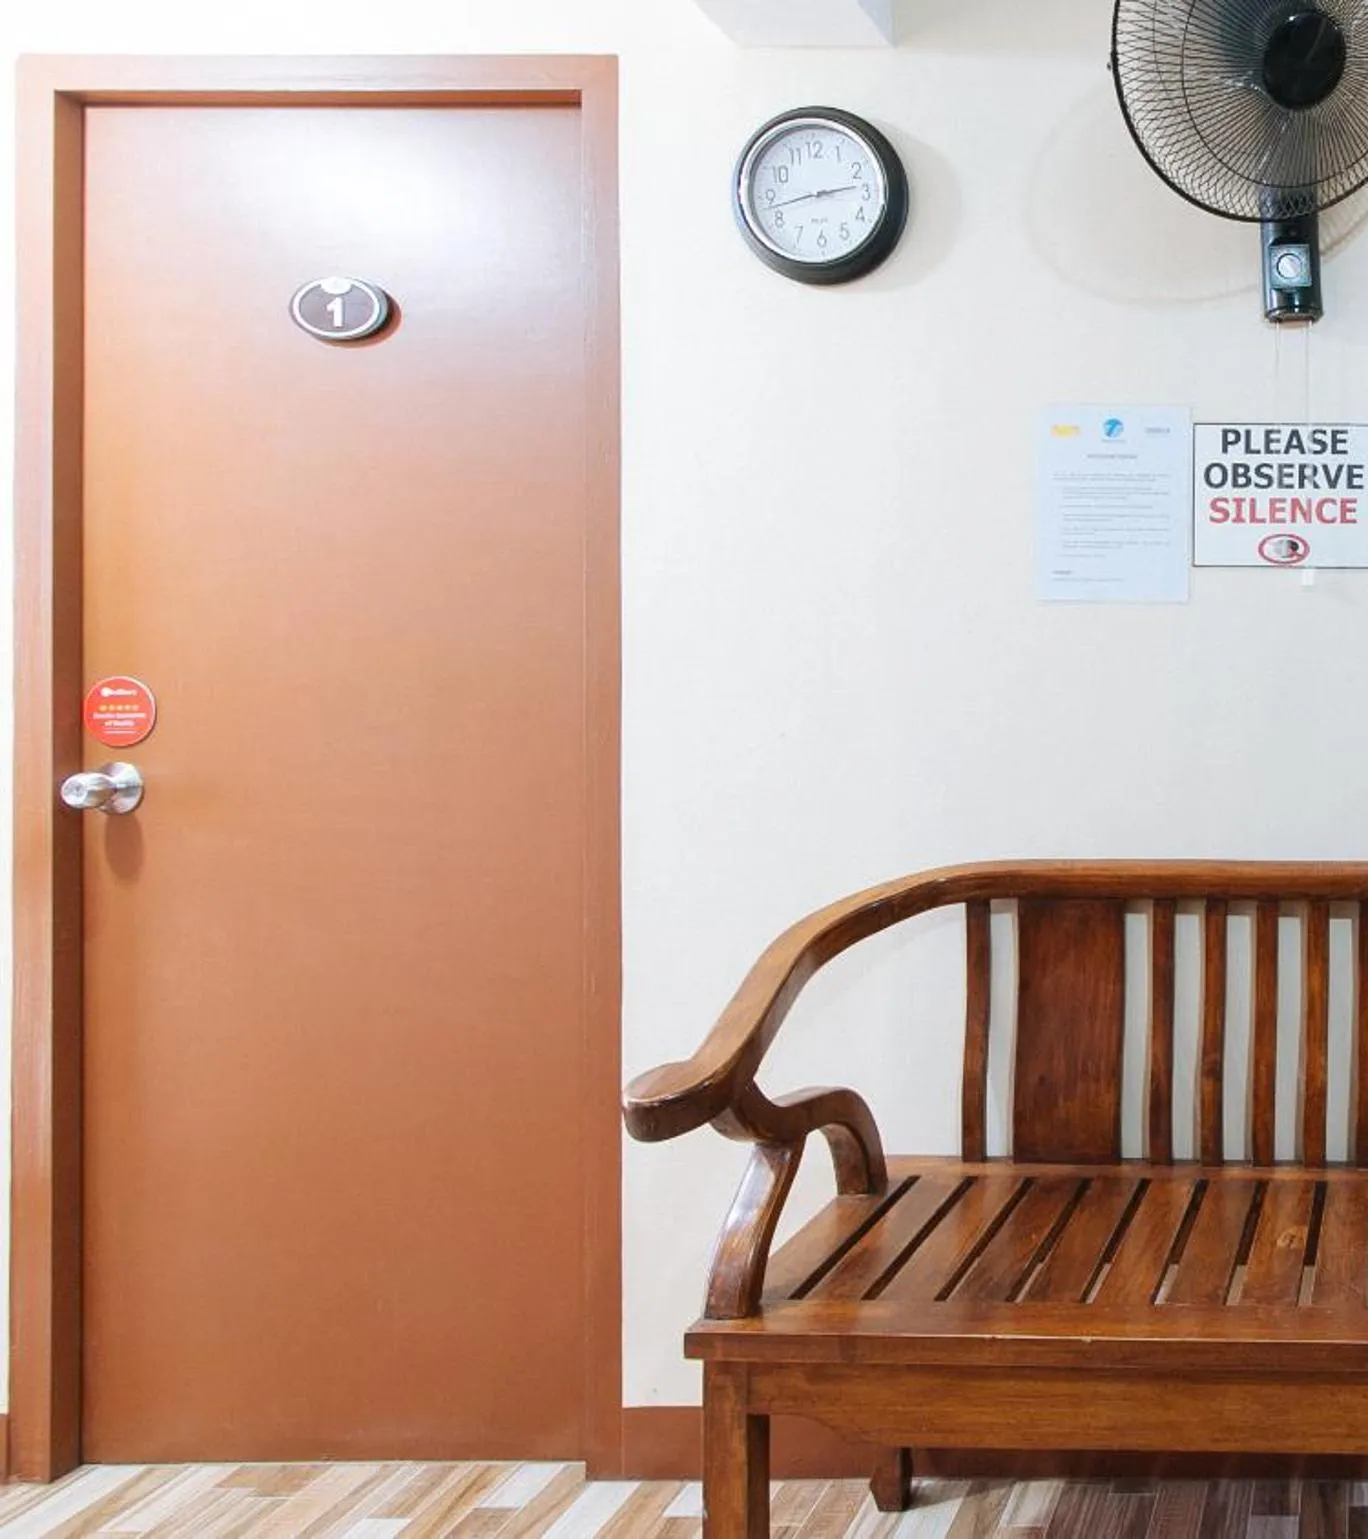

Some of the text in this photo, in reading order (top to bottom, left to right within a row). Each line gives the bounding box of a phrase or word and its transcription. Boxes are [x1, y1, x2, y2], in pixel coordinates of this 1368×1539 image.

[790, 147, 802, 165] 11
[805, 140, 823, 159] 12
[773, 165, 789, 183] 10
[851, 162, 862, 180] 2
[765, 188, 776, 205] 9
[862, 184, 871, 201] 3
[774, 210, 785, 228] 8
[855, 206, 866, 223] 4
[795, 226, 804, 244] 7
[816, 229, 828, 248] 6
[839, 222, 850, 240] 5
[326, 296, 343, 328] 1
[1221, 428, 1349, 455] PLEASE
[1203, 462, 1364, 489] OBSERVE
[1209, 497, 1358, 524] SILENCE
